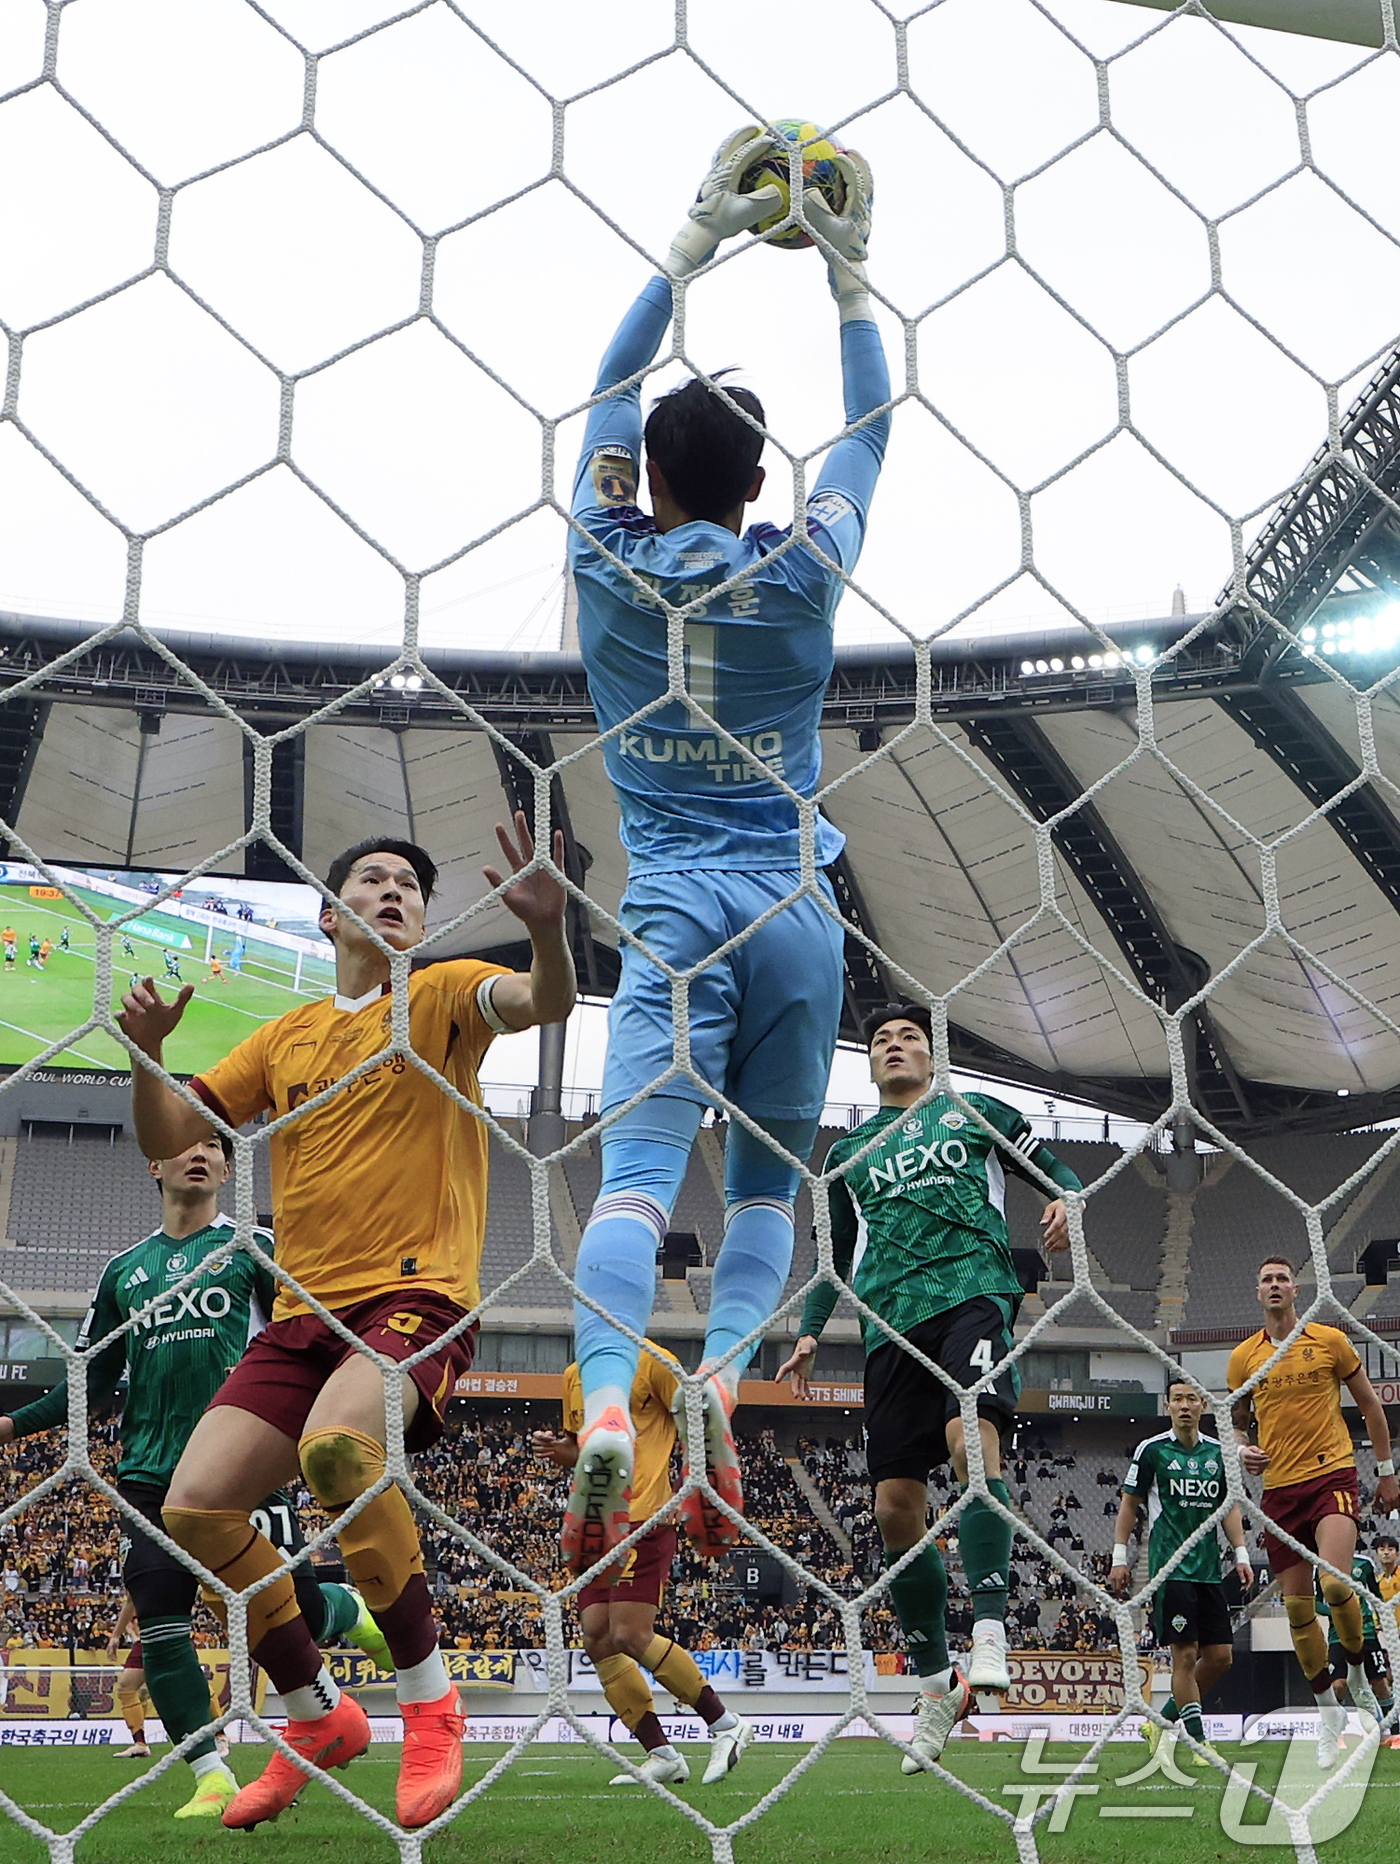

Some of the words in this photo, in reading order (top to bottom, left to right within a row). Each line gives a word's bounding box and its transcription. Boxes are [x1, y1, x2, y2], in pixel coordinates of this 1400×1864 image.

[678, 624, 716, 730] 1
[619, 731, 783, 763] KUMHO
[706, 756, 786, 782] TIRE
[25, 1072, 58, 1083] EOUL
[61, 1073, 106, 1087] WORLD
[868, 1140, 968, 1193] NEXO
[906, 1176, 955, 1191] HYUNDAI
[129, 1286, 231, 1337] NEXO
[162, 1328, 215, 1344] HYUNDAI
[969, 1339, 995, 1375] 4
[11, 1364, 28, 1380] FC
[455, 1378, 482, 1392] 아컵
[485, 1378, 518, 1393] 결승전
[1049, 1394, 1095, 1410] GWANGJU
[1098, 1396, 1111, 1410] FC
[1170, 1479, 1220, 1498] NEXO
[1332, 1490, 1353, 1514] 11
[746, 1567, 760, 1585] B
[1259, 1568, 1270, 1585] A
[1370, 1651, 1386, 1667] 13
[1007, 1683, 1047, 1706] TO
[1, 1729, 77, 1746] 한국축구의
[82, 1728, 112, 1745] 내일
[778, 1724, 804, 1739] 내일
